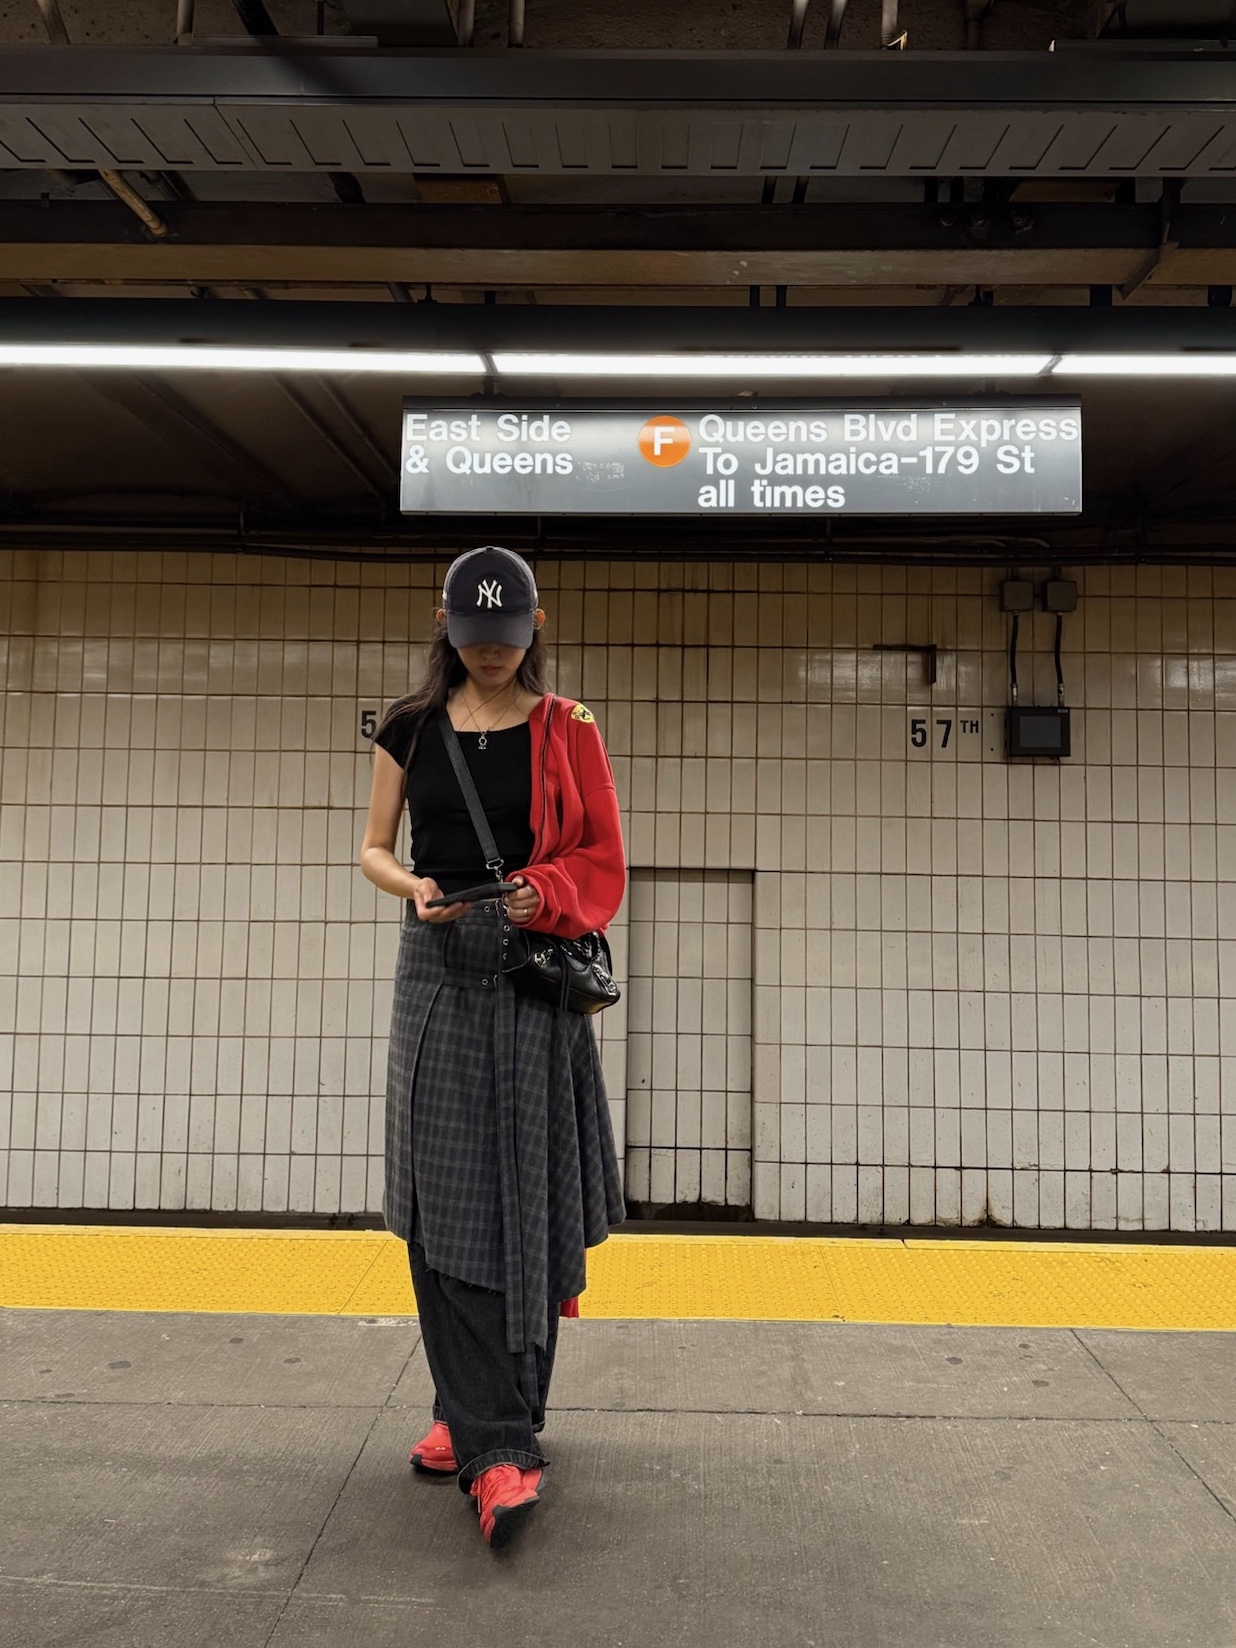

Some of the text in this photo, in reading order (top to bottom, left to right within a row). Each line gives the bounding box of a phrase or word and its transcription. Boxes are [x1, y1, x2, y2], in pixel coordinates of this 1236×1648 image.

[405, 413, 572, 442] East Side
[653, 426, 675, 456] F
[698, 413, 1079, 448] Queens Blvd Express
[405, 444, 574, 475] & Queens
[698, 444, 1036, 475] To Jamaica-179 St
[697, 478, 846, 508] all times
[476, 579, 503, 609] NY
